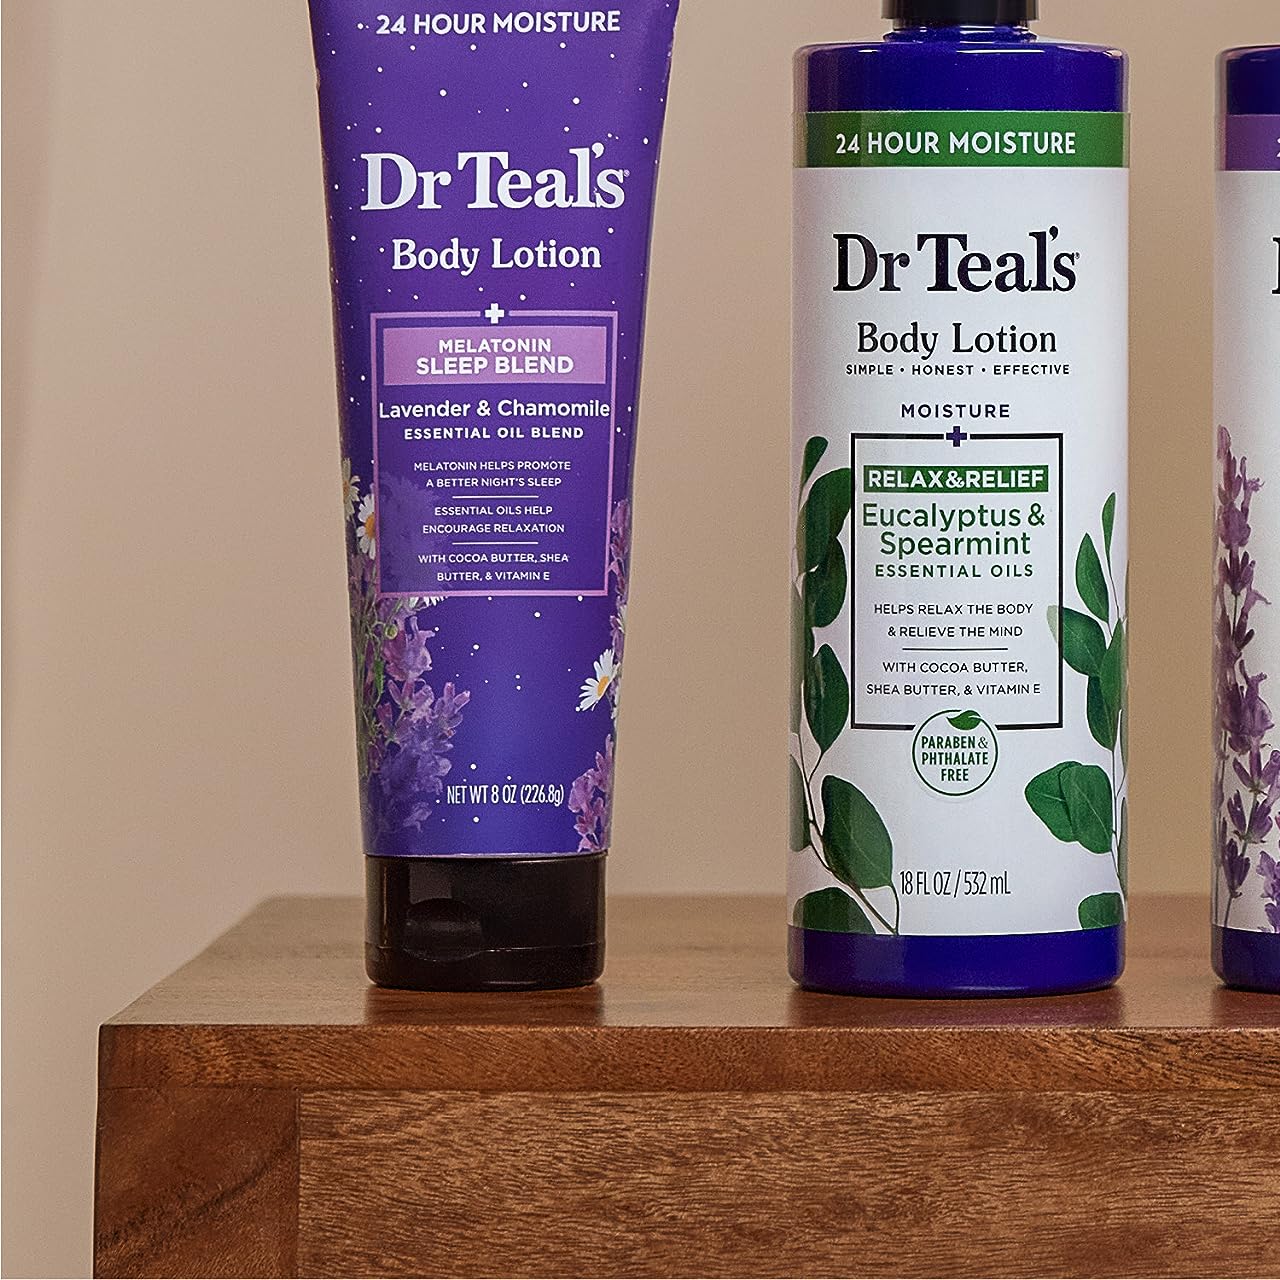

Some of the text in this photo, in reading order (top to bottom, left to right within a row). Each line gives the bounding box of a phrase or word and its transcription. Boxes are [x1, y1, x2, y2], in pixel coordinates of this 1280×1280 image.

[376, 11, 620, 34] 24 HOUR MOISTURE
[836, 132, 1075, 154] 24 HOUR MOISTURE
[361, 143, 624, 210] Dr Teal's
[392, 238, 601, 276] Body Lotion
[833, 226, 1077, 292] Dr Teal's
[438, 337, 551, 354] MELATONIN
[858, 322, 1056, 360] Body Lotion
[417, 356, 573, 374] SLEEP BLEND
[845, 363, 1070, 376] SIMPLE HONEST EFFECTIVE
[380, 399, 609, 418] Lavender Chamomile
[901, 403, 1010, 419] MOISTURE
[404, 426, 584, 440] ESSENTIAL OIL BLEND
[413, 460, 571, 472] MELATONIN HELPS PROMOTE
[425, 477, 562, 488] A BETTER NIGHT'S SLEEP
[434, 505, 553, 516] ESSENTIAL OILS HELP
[863, 503, 1020, 532] Eucalyptus
[422, 523, 565, 534] ENCOURAGE RELAXATION
[880, 531, 1030, 560] Spearmint
[417, 553, 569, 564] WITH COCOA BUTTER, SHEA
[436, 571, 541, 582] BUTTER, VITAMIN
[875, 563, 1033, 578] ESSENTIAL OILS
[873, 603, 1034, 615] HELPS RELAX THE BODY
[899, 625, 1023, 638] RELIEVE THE MIND
[882, 661, 1028, 674] WITH COCOA BUTTER,
[866, 683, 1030, 697] SHEA BUTTER, VITAMIN
[921, 735, 976, 750] PARABEN
[921, 751, 989, 766] PHTHALATE
[940, 767, 969, 782] FREE
[448, 784, 564, 806] NET WT 8 OZ (226.8g)
[900, 871, 1010, 895] 18 FL OZ 532 mL
